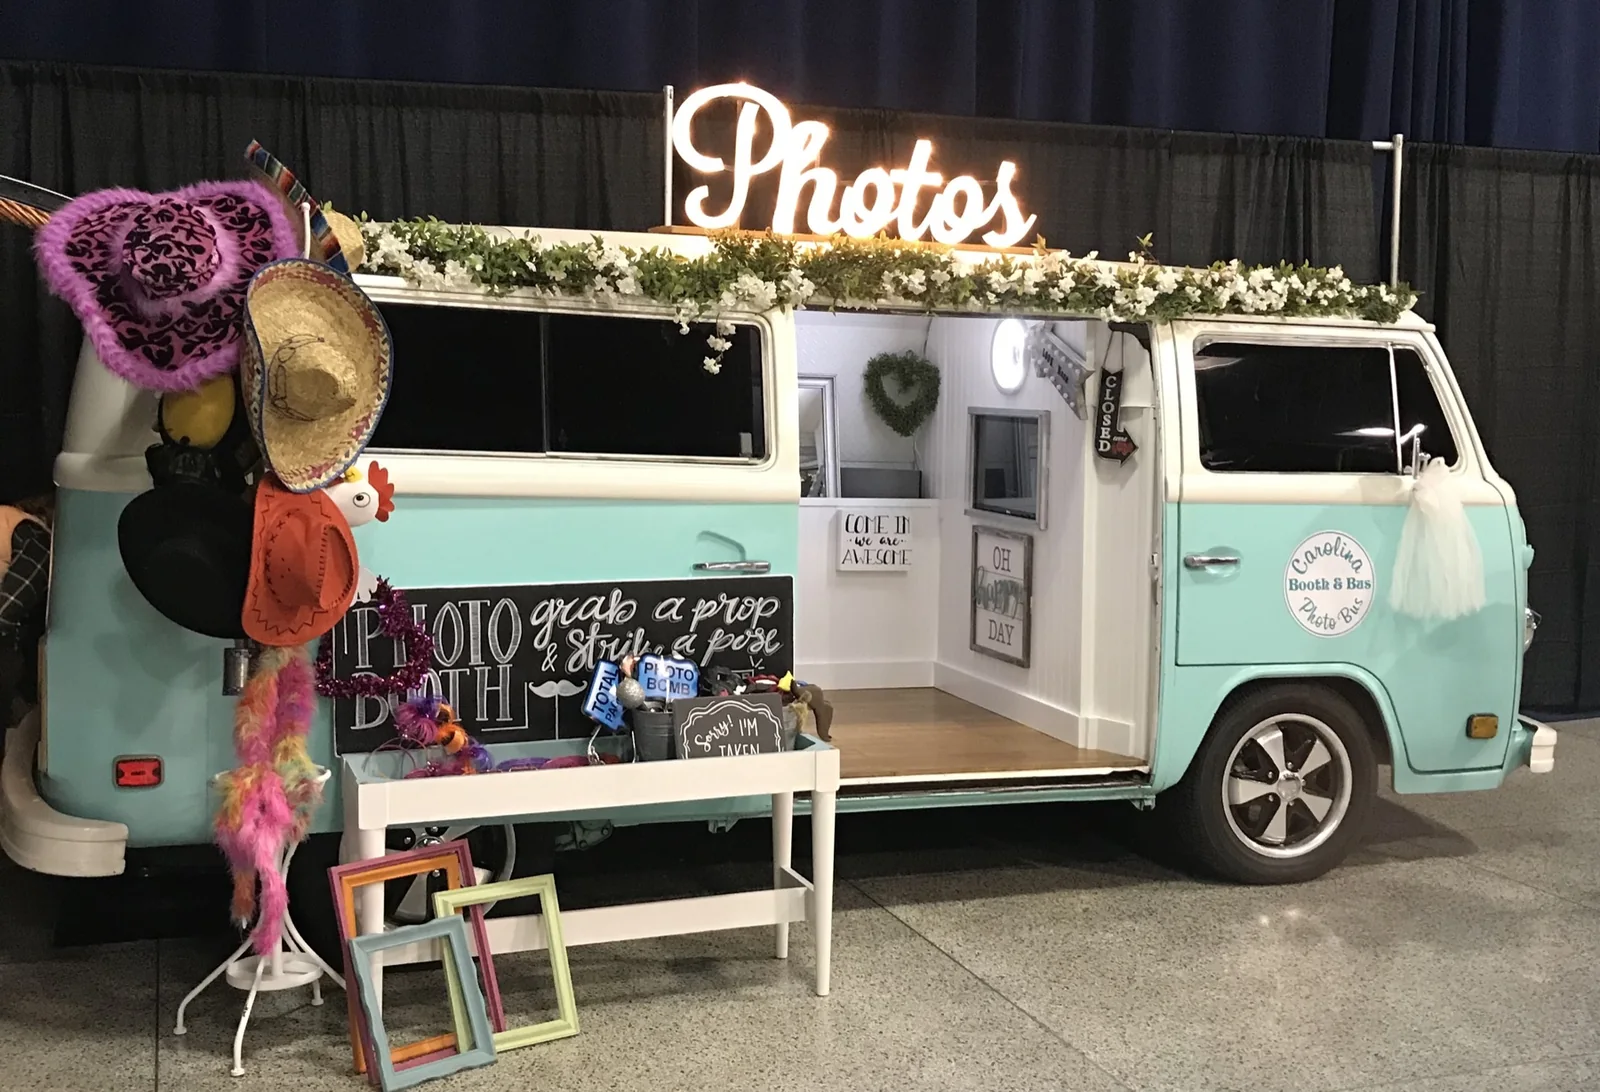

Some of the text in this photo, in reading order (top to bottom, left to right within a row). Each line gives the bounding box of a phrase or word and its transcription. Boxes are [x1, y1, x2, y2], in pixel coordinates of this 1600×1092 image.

[672, 83, 1037, 248] Photos
[1097, 375, 1118, 452] CLOSED
[845, 514, 910, 534] COME IN
[841, 549, 912, 565] AWESOME
[855, 537, 900, 547] we are
[1291, 536, 1363, 574] Carolina
[993, 546, 1011, 572] OH
[1288, 577, 1371, 591] Booth & Bus
[530, 588, 782, 650] grab a prop
[1299, 597, 1363, 630] Photo Bus
[988, 619, 1015, 646] DAY
[541, 642, 559, 673] &
[671, 632, 697, 655] a
[701, 627, 784, 667] pose
[592, 669, 618, 713] TOTAL
[646, 677, 690, 695] BOMB
[694, 714, 759, 752] Sorry! I'M
[719, 743, 760, 757] TAKEN
